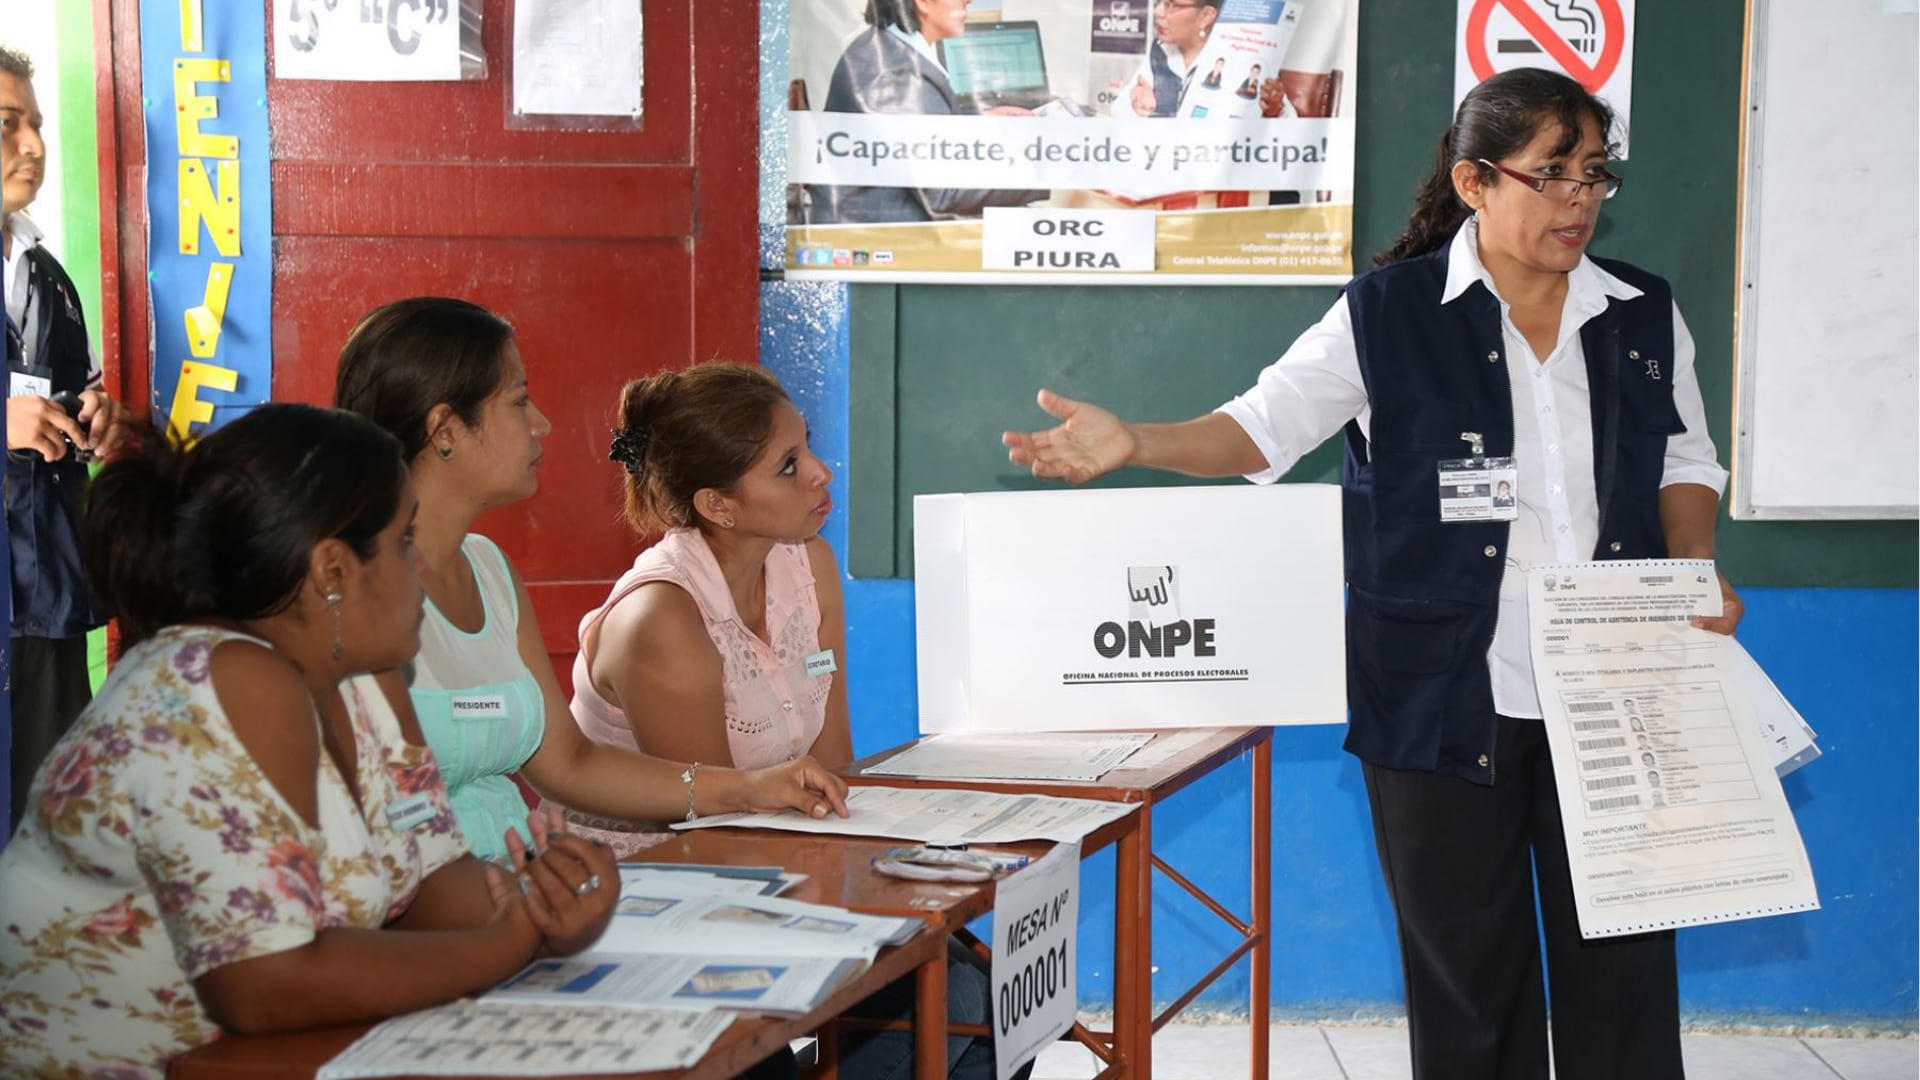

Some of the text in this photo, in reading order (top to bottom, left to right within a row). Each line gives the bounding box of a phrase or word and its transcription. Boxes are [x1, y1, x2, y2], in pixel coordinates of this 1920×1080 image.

[1100, 20, 1140, 32] ONPE
[1023, 135, 1132, 163] decide
[1142, 142, 1162, 171] y
[1172, 136, 1328, 171] participa!
[1032, 219, 1104, 236] ORC
[1013, 250, 1121, 268] PIURA
[1093, 618, 1217, 659] ONPE
[1063, 672, 1096, 680] OFICINA
[1141, 671, 1152, 679] DE
[1154, 670, 1195, 678] PROCESOS
[1197, 669, 1249, 677] ELECTORALES
[453, 701, 501, 710] PRESIDENTE
[1007, 903, 1048, 957] MESA
[1000, 938, 1067, 1037] 000001
